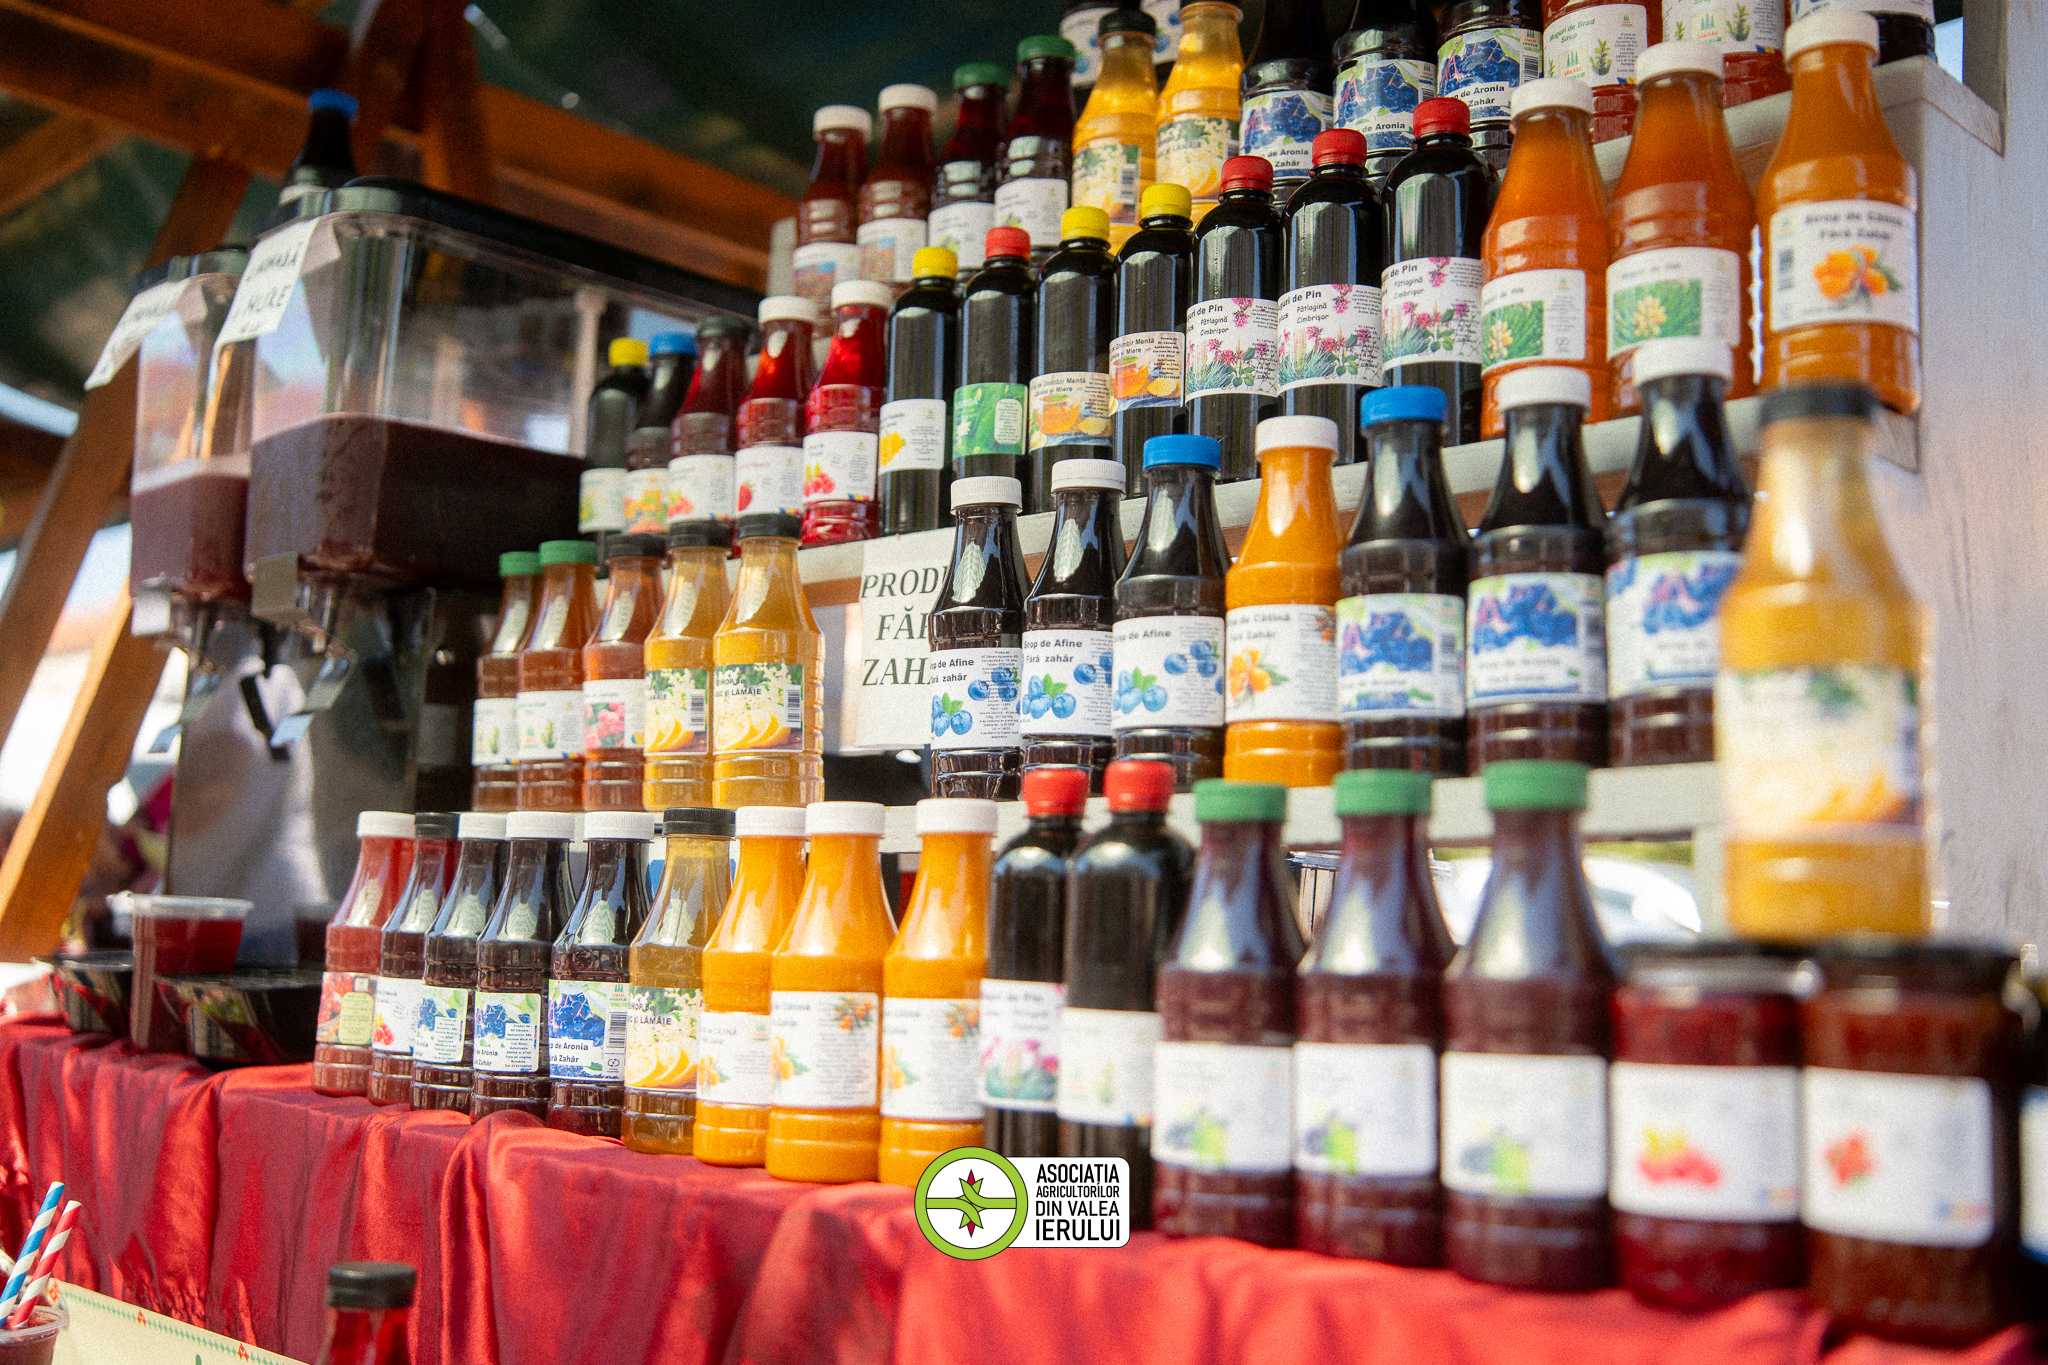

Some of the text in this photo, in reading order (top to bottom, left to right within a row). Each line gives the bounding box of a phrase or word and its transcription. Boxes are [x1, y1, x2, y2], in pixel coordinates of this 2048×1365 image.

[1473, 85, 1505, 94] Aronia
[1375, 121, 1406, 131] Aronia
[1280, 148, 1309, 156] Aronia
[1402, 264, 1418, 274] Pin
[1291, 293, 1303, 302] de
[1305, 290, 1322, 299] Pin
[1196, 307, 1206, 316] de
[1208, 304, 1223, 313] Pin
[1135, 337, 1155, 345] Mentă
[1125, 347, 1142, 355] Miere
[1142, 629, 1172, 638] Afine
[1040, 639, 1051, 647] de
[1054, 638, 1083, 648] Afine
[937, 660, 947, 668] de
[949, 658, 975, 667] Afine
[1045, 653, 1074, 663] zahăr
[862, 657, 931, 686] ZAH
[942, 672, 968, 682] zahăr
[563, 1042, 589, 1051] Aronia
